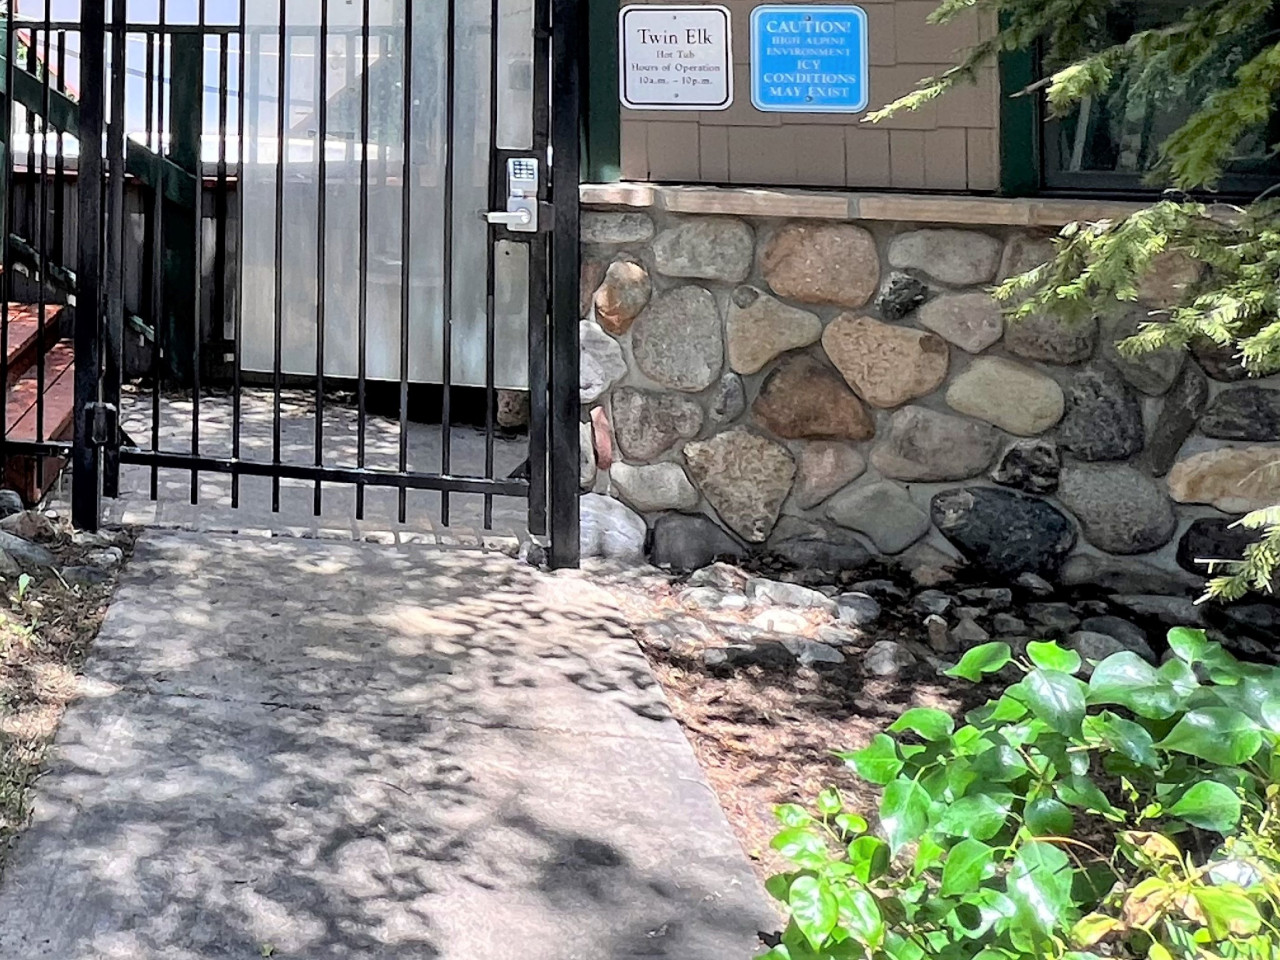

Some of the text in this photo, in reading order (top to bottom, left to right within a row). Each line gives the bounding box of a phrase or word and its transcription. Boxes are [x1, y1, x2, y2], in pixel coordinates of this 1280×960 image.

[766, 20, 851, 34] CAUTION!
[637, 28, 713, 44] Twin Elk
[771, 36, 846, 45] HIGH ALPINE
[656, 50, 695, 59] Hot Tub
[766, 47, 850, 56] ENVIRONMENT
[631, 62, 721, 73] Hours of Operation
[797, 59, 821, 70] ICY
[639, 76, 669, 84] 10a.m.
[682, 76, 713, 86] 10p.m.
[763, 72, 857, 84] CONDITIONS
[769, 86, 850, 98] MAY EXIST
